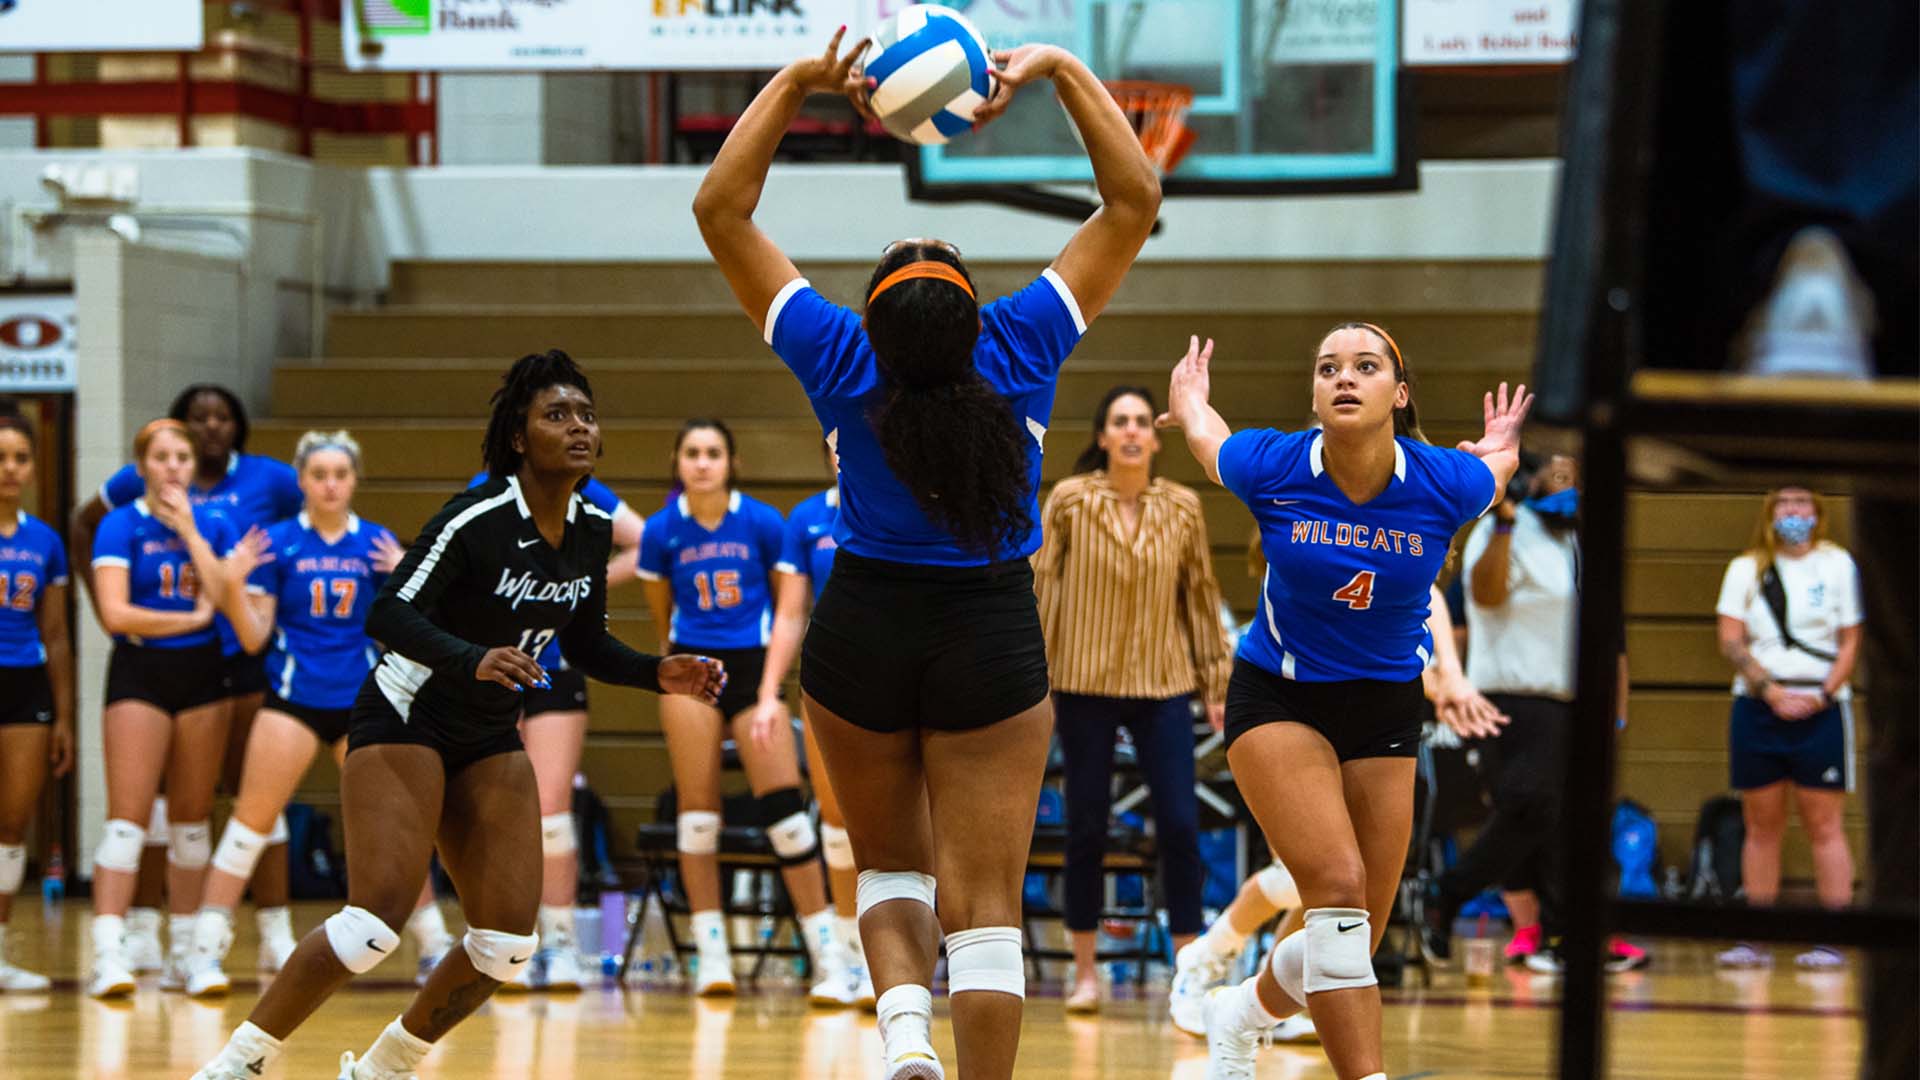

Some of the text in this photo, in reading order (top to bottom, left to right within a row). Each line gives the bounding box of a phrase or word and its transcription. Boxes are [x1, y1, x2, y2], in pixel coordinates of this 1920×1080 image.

[438, 10, 518, 31] Bank
[1291, 520, 1423, 557] WILDCATS
[0, 571, 37, 612] 12
[310, 577, 358, 618] 17
[494, 567, 592, 612] WILDCATS
[694, 569, 742, 611] 15
[1332, 570, 1376, 610] 4
